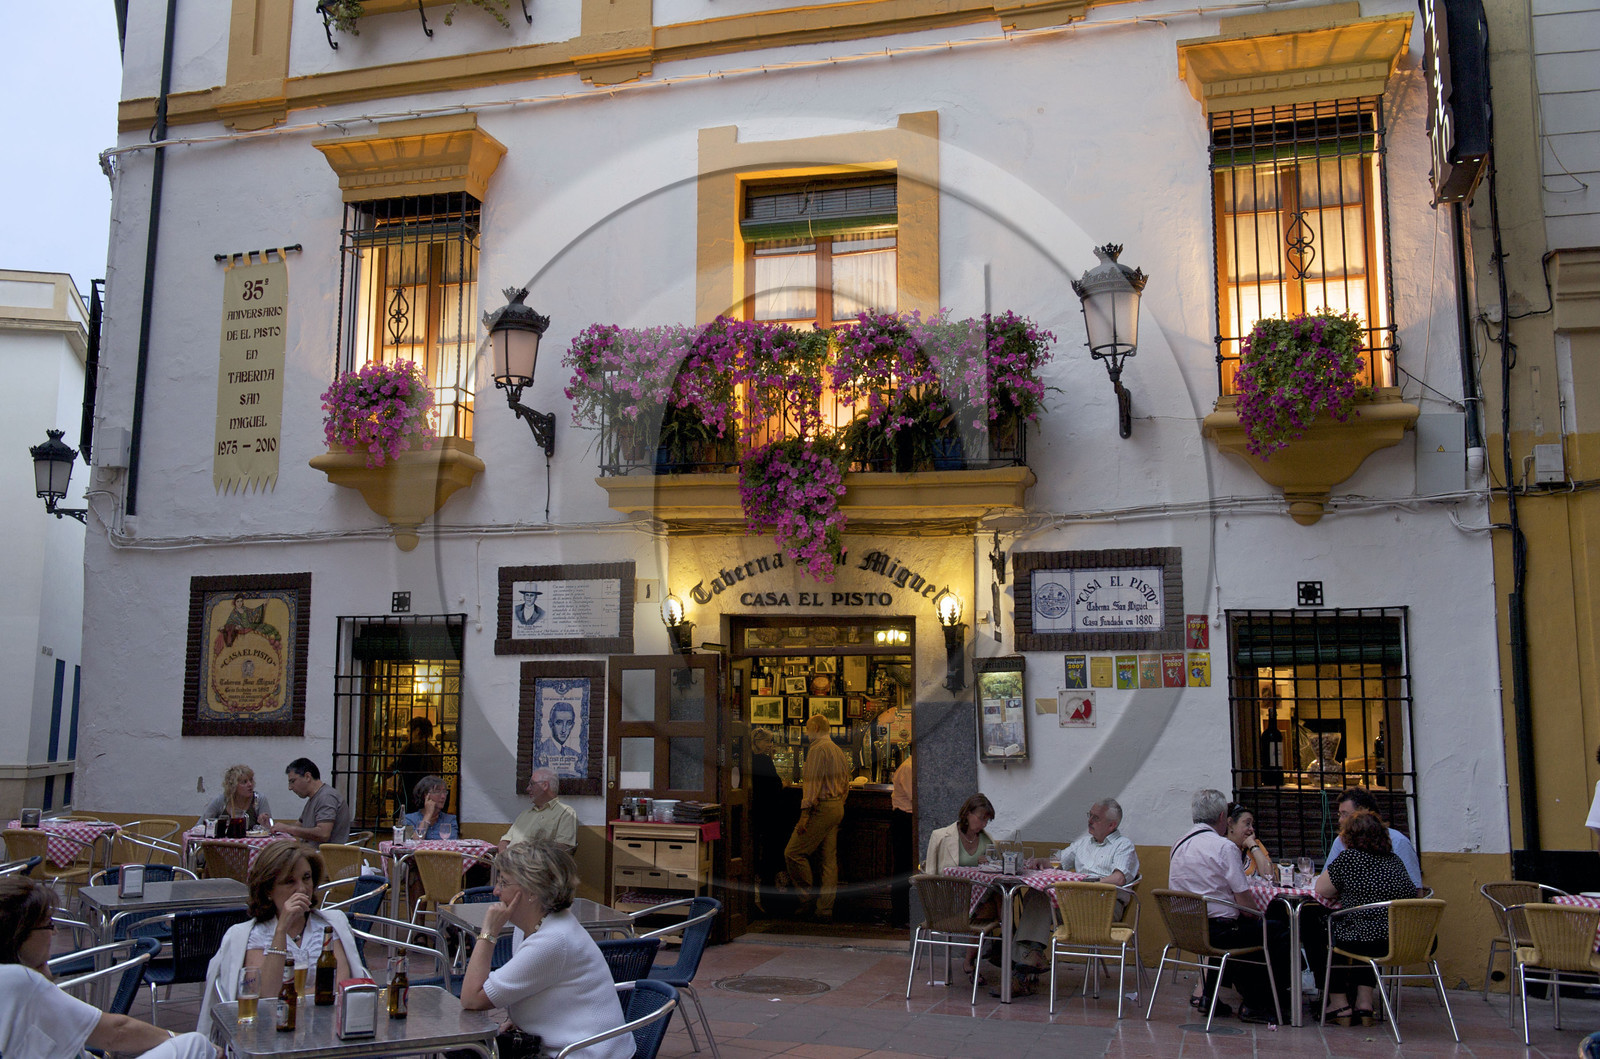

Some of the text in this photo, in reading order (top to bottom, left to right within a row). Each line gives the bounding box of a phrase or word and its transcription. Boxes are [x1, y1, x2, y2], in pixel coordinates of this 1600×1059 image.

[226, 306, 283, 320] ANIVERSARIO
[226, 326, 281, 341] DE EL PISTO
[245, 349, 259, 361] EN
[227, 368, 275, 384] TABERNA
[239, 392, 260, 406] SAN
[229, 415, 268, 430] MIGUEL
[217, 440, 239, 456] 1975
[255, 436, 277, 453] 2010
[689, 550, 949, 605] Taberna Miguel
[1110, 575, 1123, 587] EL
[740, 592, 893, 607] CASA EL PISTO
[1086, 600, 1148, 612] Taberna San Miguel
[1082, 615, 1098, 627] Casa
[242, 648, 252, 656] EL
